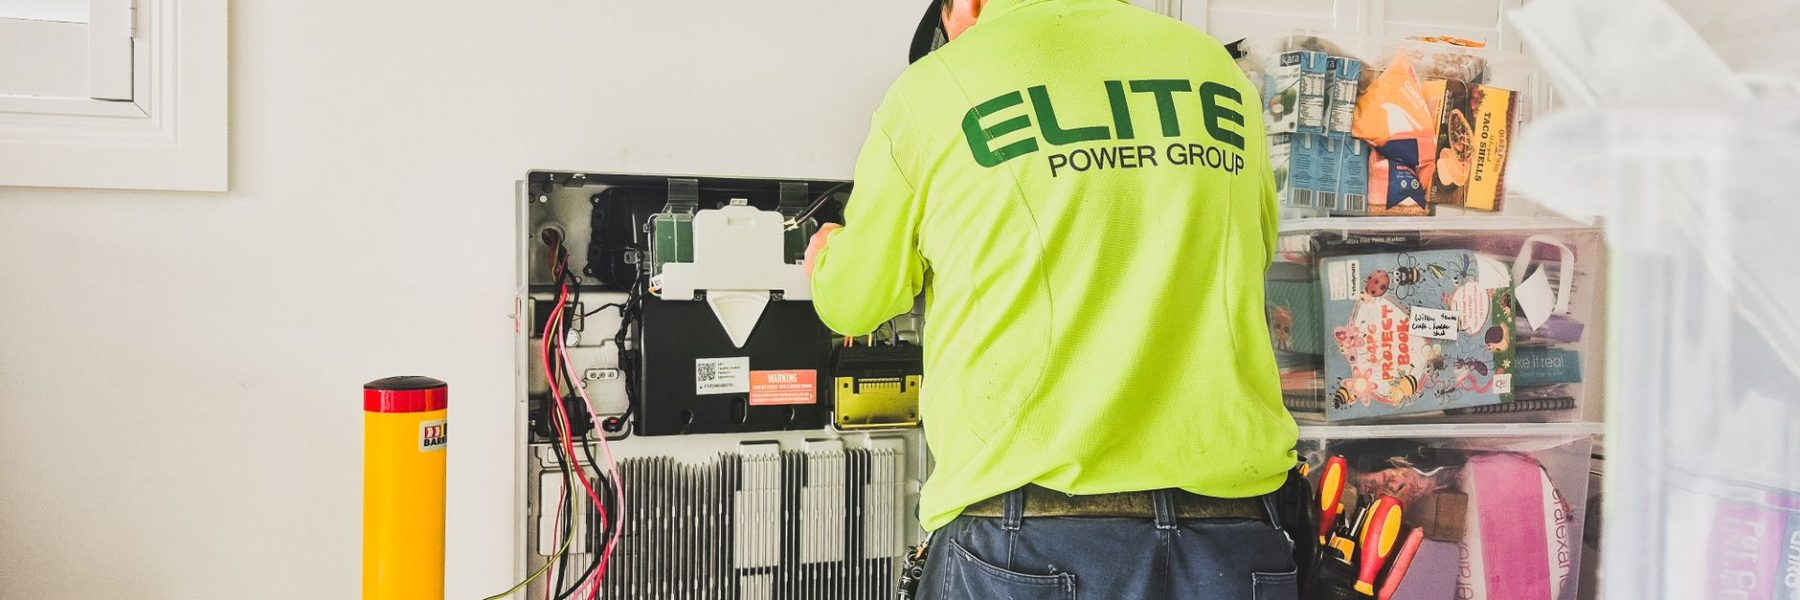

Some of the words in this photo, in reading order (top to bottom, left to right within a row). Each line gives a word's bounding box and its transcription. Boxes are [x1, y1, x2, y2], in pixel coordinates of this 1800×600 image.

[961, 79, 1245, 168] ELITE
[1480, 112, 1491, 139] TACO
[1048, 145, 1157, 178] POWER
[1166, 143, 1245, 176] GROUP
[1474, 142, 1487, 182] SHELLS
[1381, 304, 1393, 381] PROJECT
[1397, 318, 1410, 366] BOOK
[767, 373, 798, 384] WARNING
